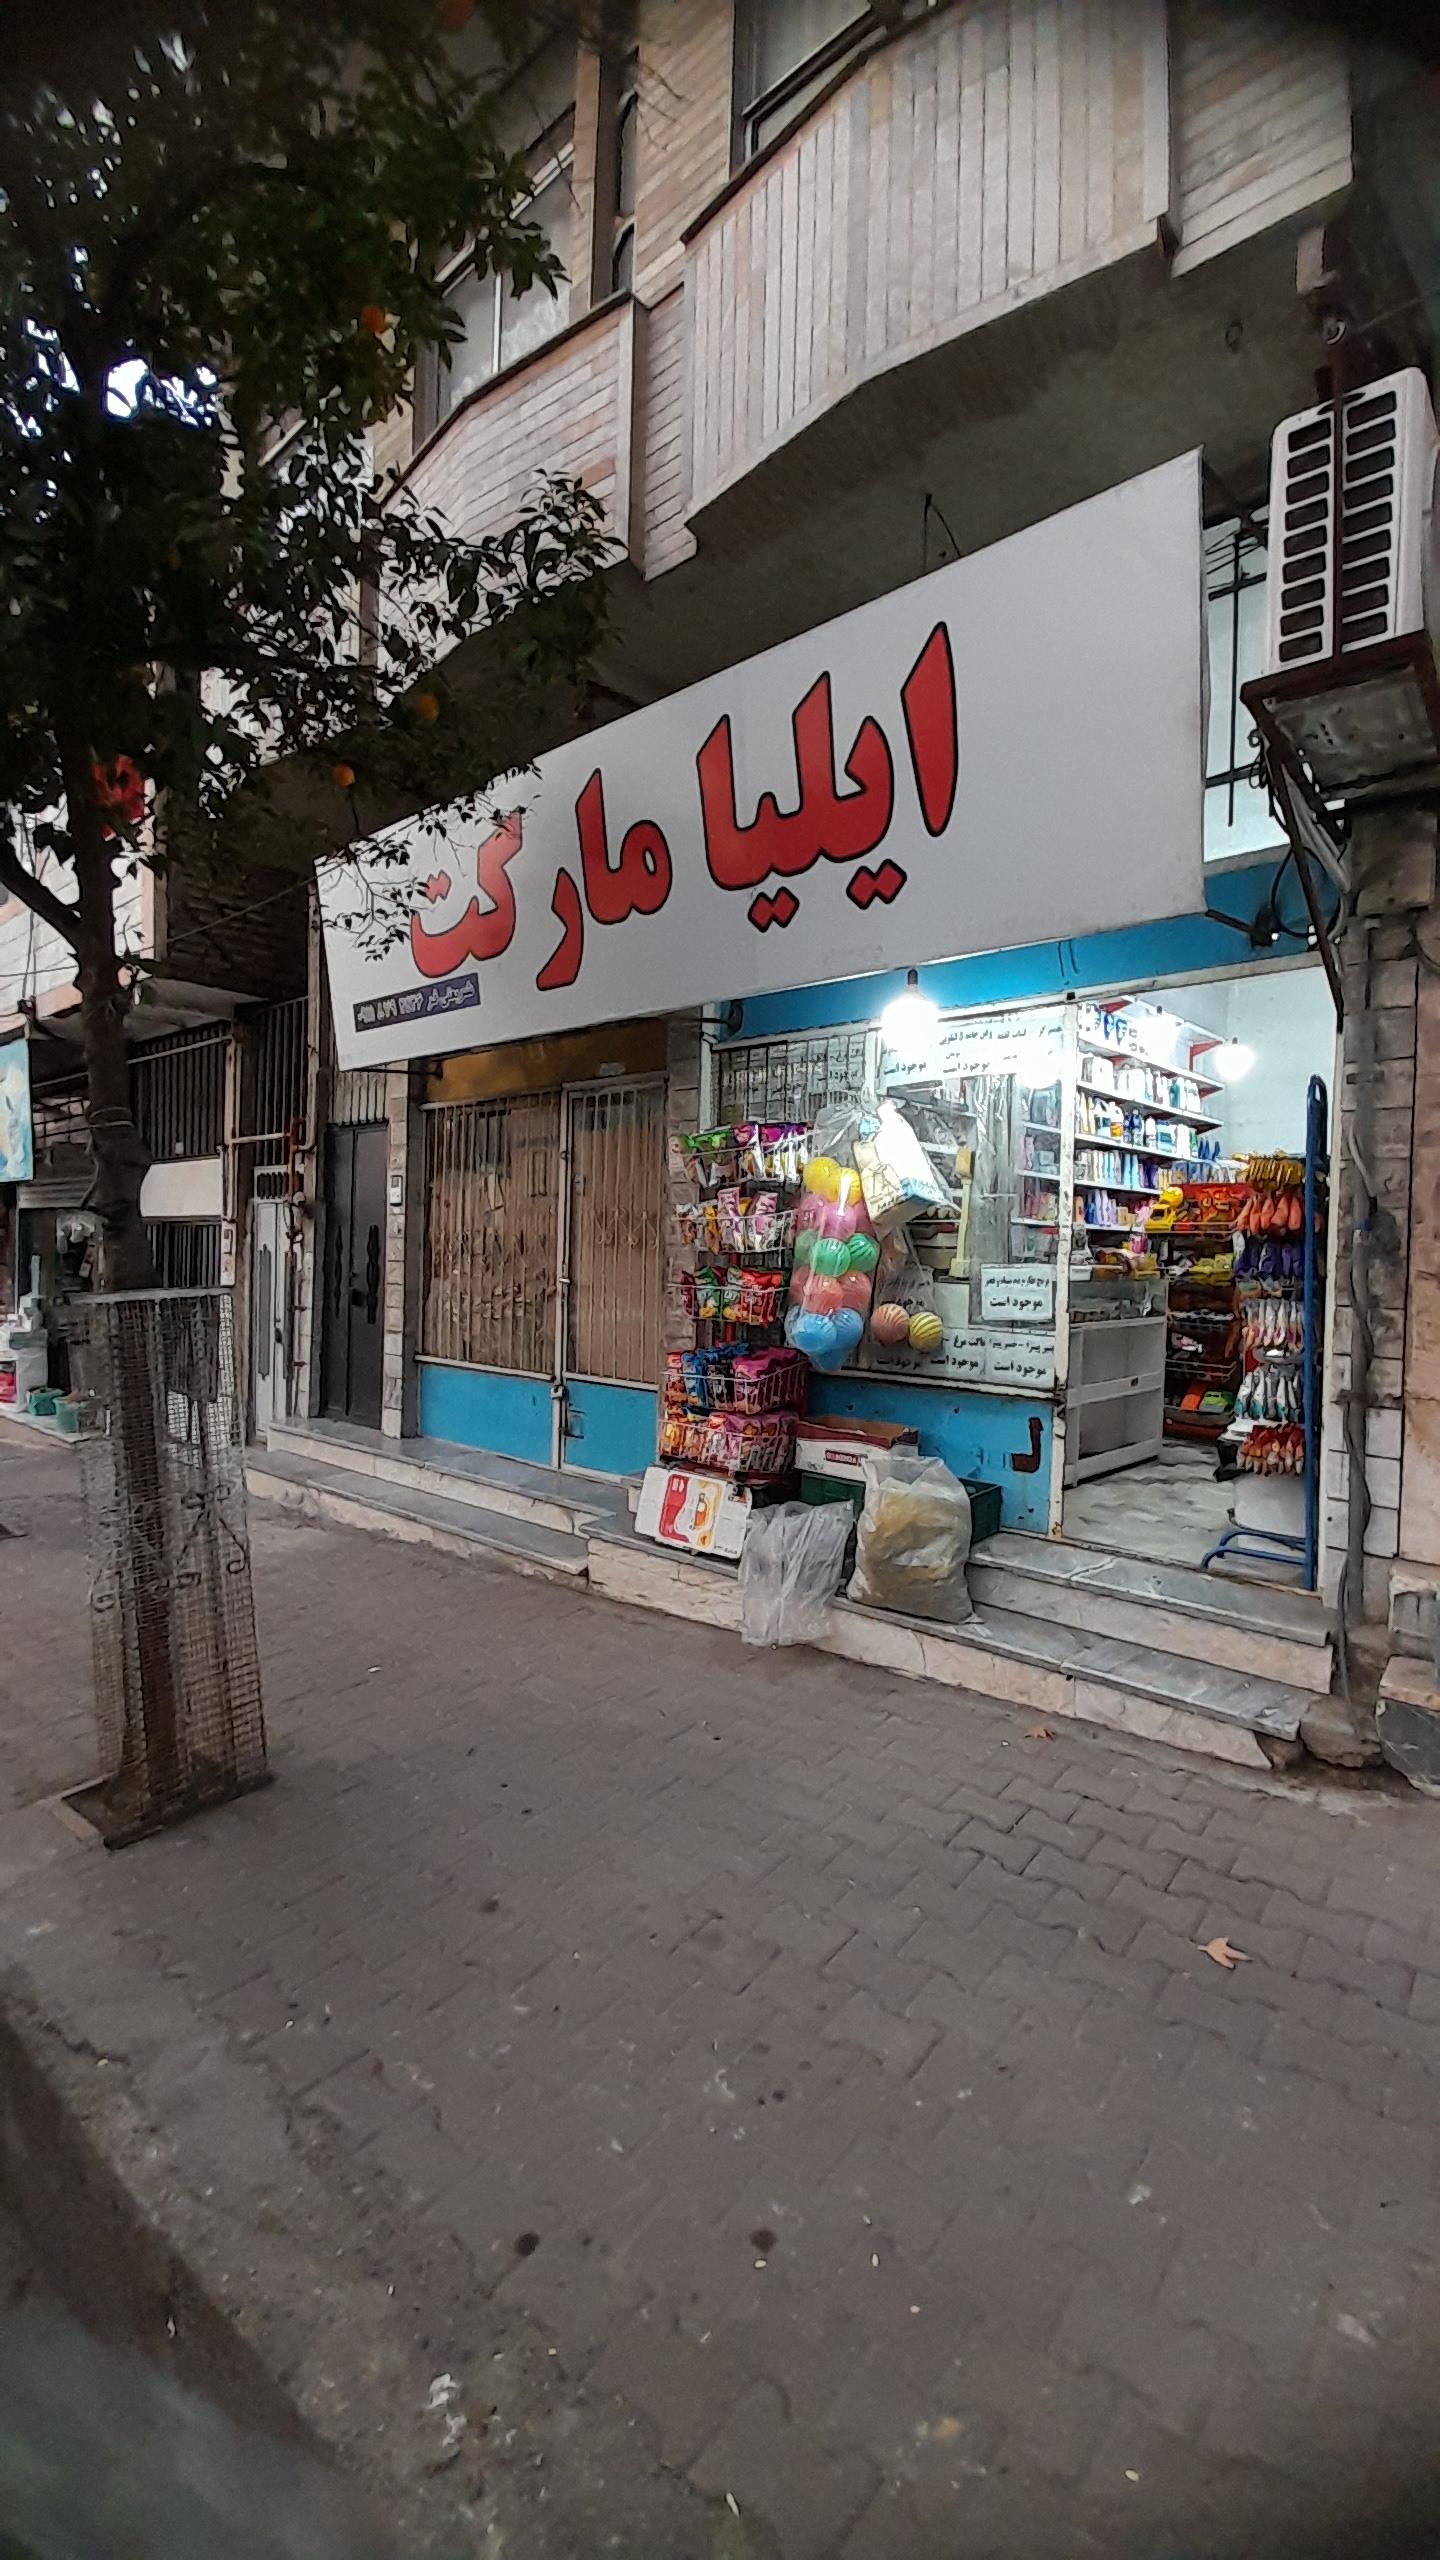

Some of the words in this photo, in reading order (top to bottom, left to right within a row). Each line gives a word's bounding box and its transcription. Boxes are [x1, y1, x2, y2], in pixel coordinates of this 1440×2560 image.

[695, 620, 960, 932] ایلیا
[409, 767, 673, 991] مارکت
[989, 1295, 1011, 1307] است
[1011, 1298, 1044, 1311] موجود
[951, 1355, 979, 1370] موجود
[993, 1359, 1014, 1371] است
[1015, 1362, 1047, 1379] موجود
